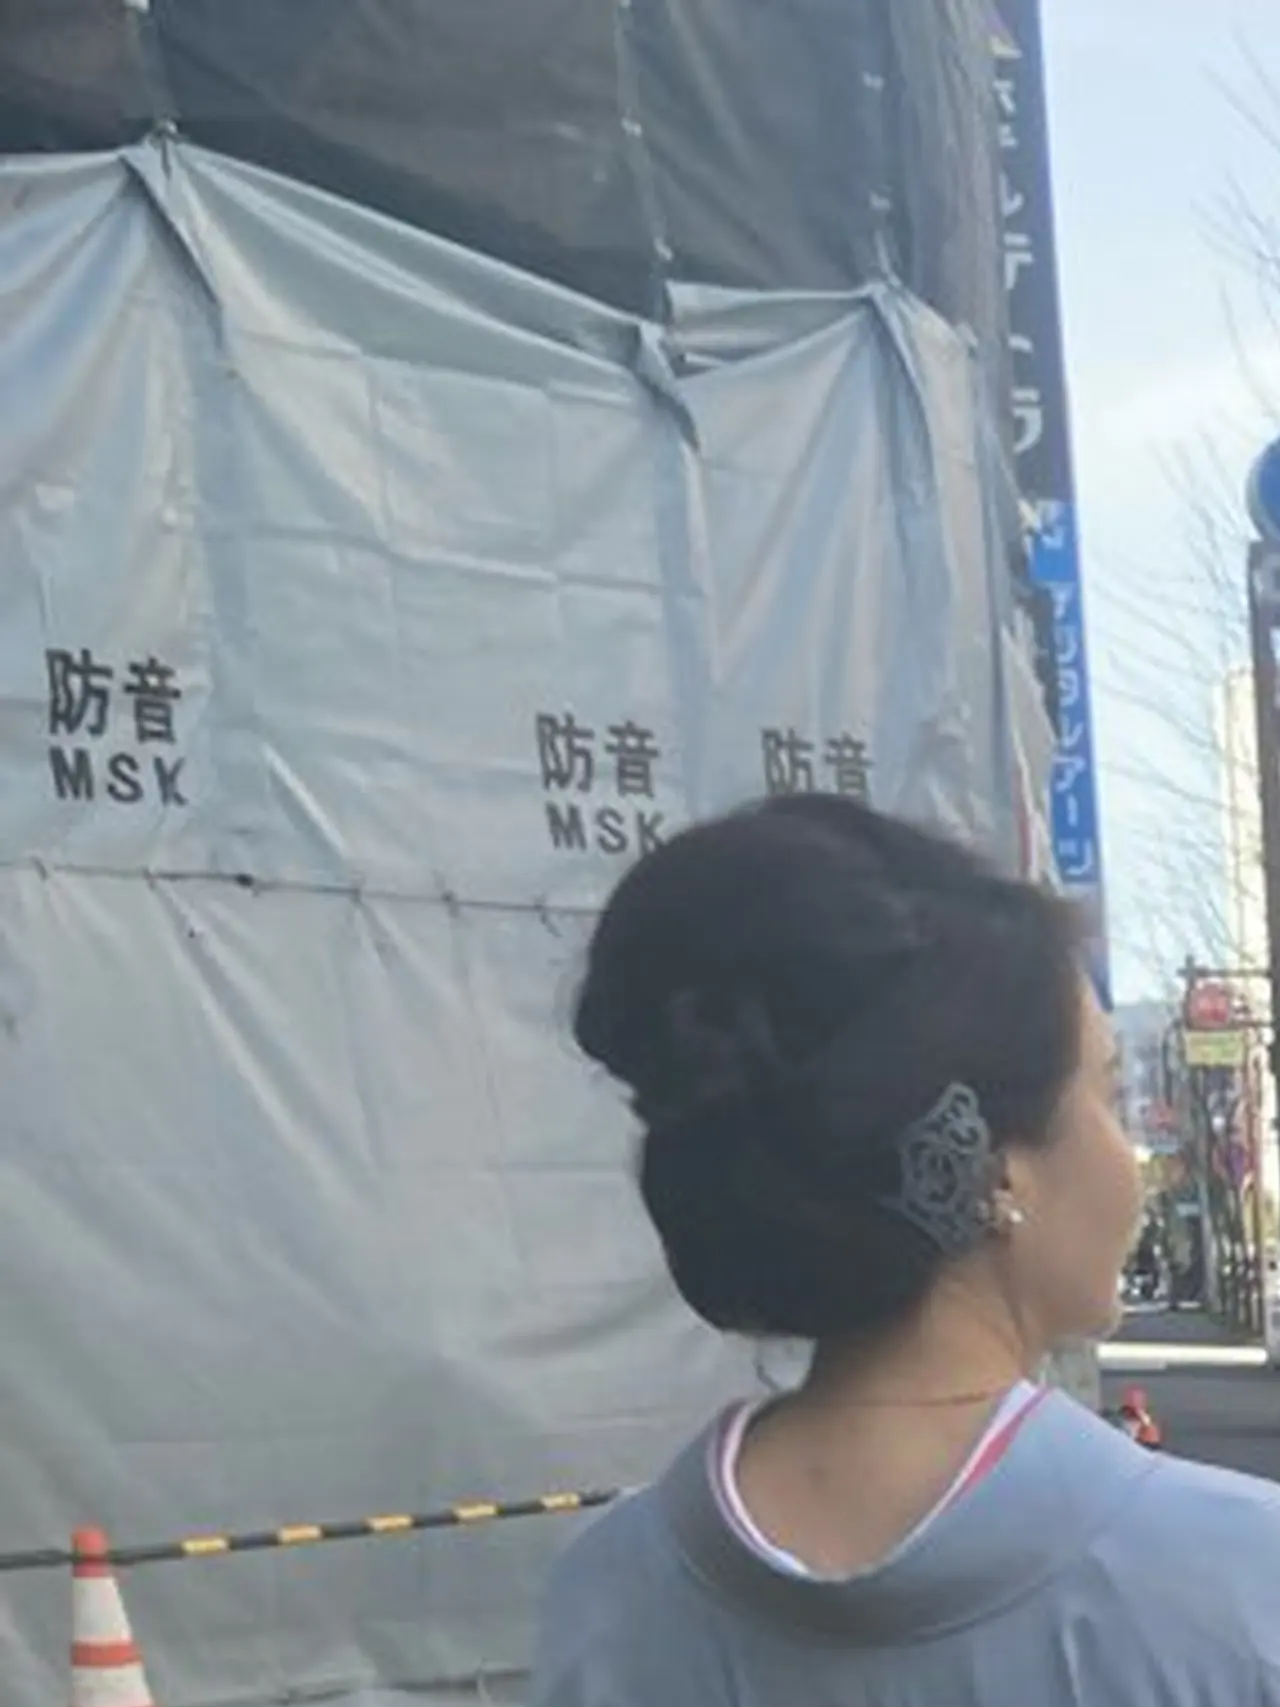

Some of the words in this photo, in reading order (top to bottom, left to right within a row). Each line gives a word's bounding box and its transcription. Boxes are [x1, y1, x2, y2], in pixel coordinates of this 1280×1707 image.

[46, 647, 182, 745] 防音
[49, 745, 188, 806] MSK
[536, 711, 660, 798] 防音
[545, 801, 665, 855] MSK
